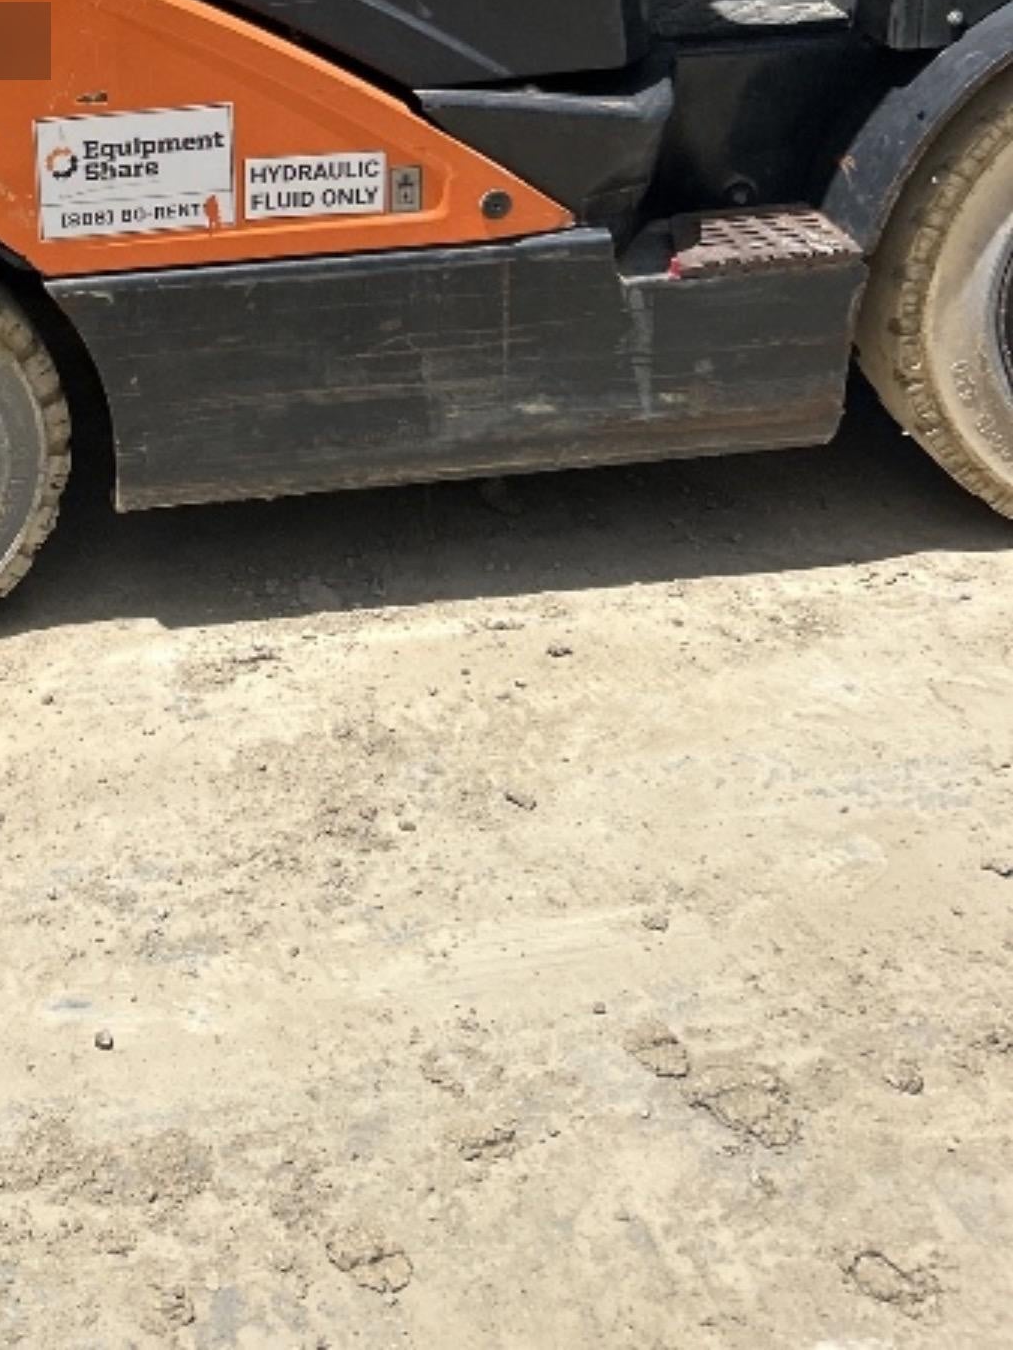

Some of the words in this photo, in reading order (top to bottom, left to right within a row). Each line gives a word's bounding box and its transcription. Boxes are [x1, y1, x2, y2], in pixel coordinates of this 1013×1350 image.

[82, 131, 225, 160] Equipment
[85, 161, 159, 181] Share
[250, 158, 381, 184] HYDRAULIC
[251, 190, 315, 211] FLUID
[321, 185, 379, 207] ONLY
